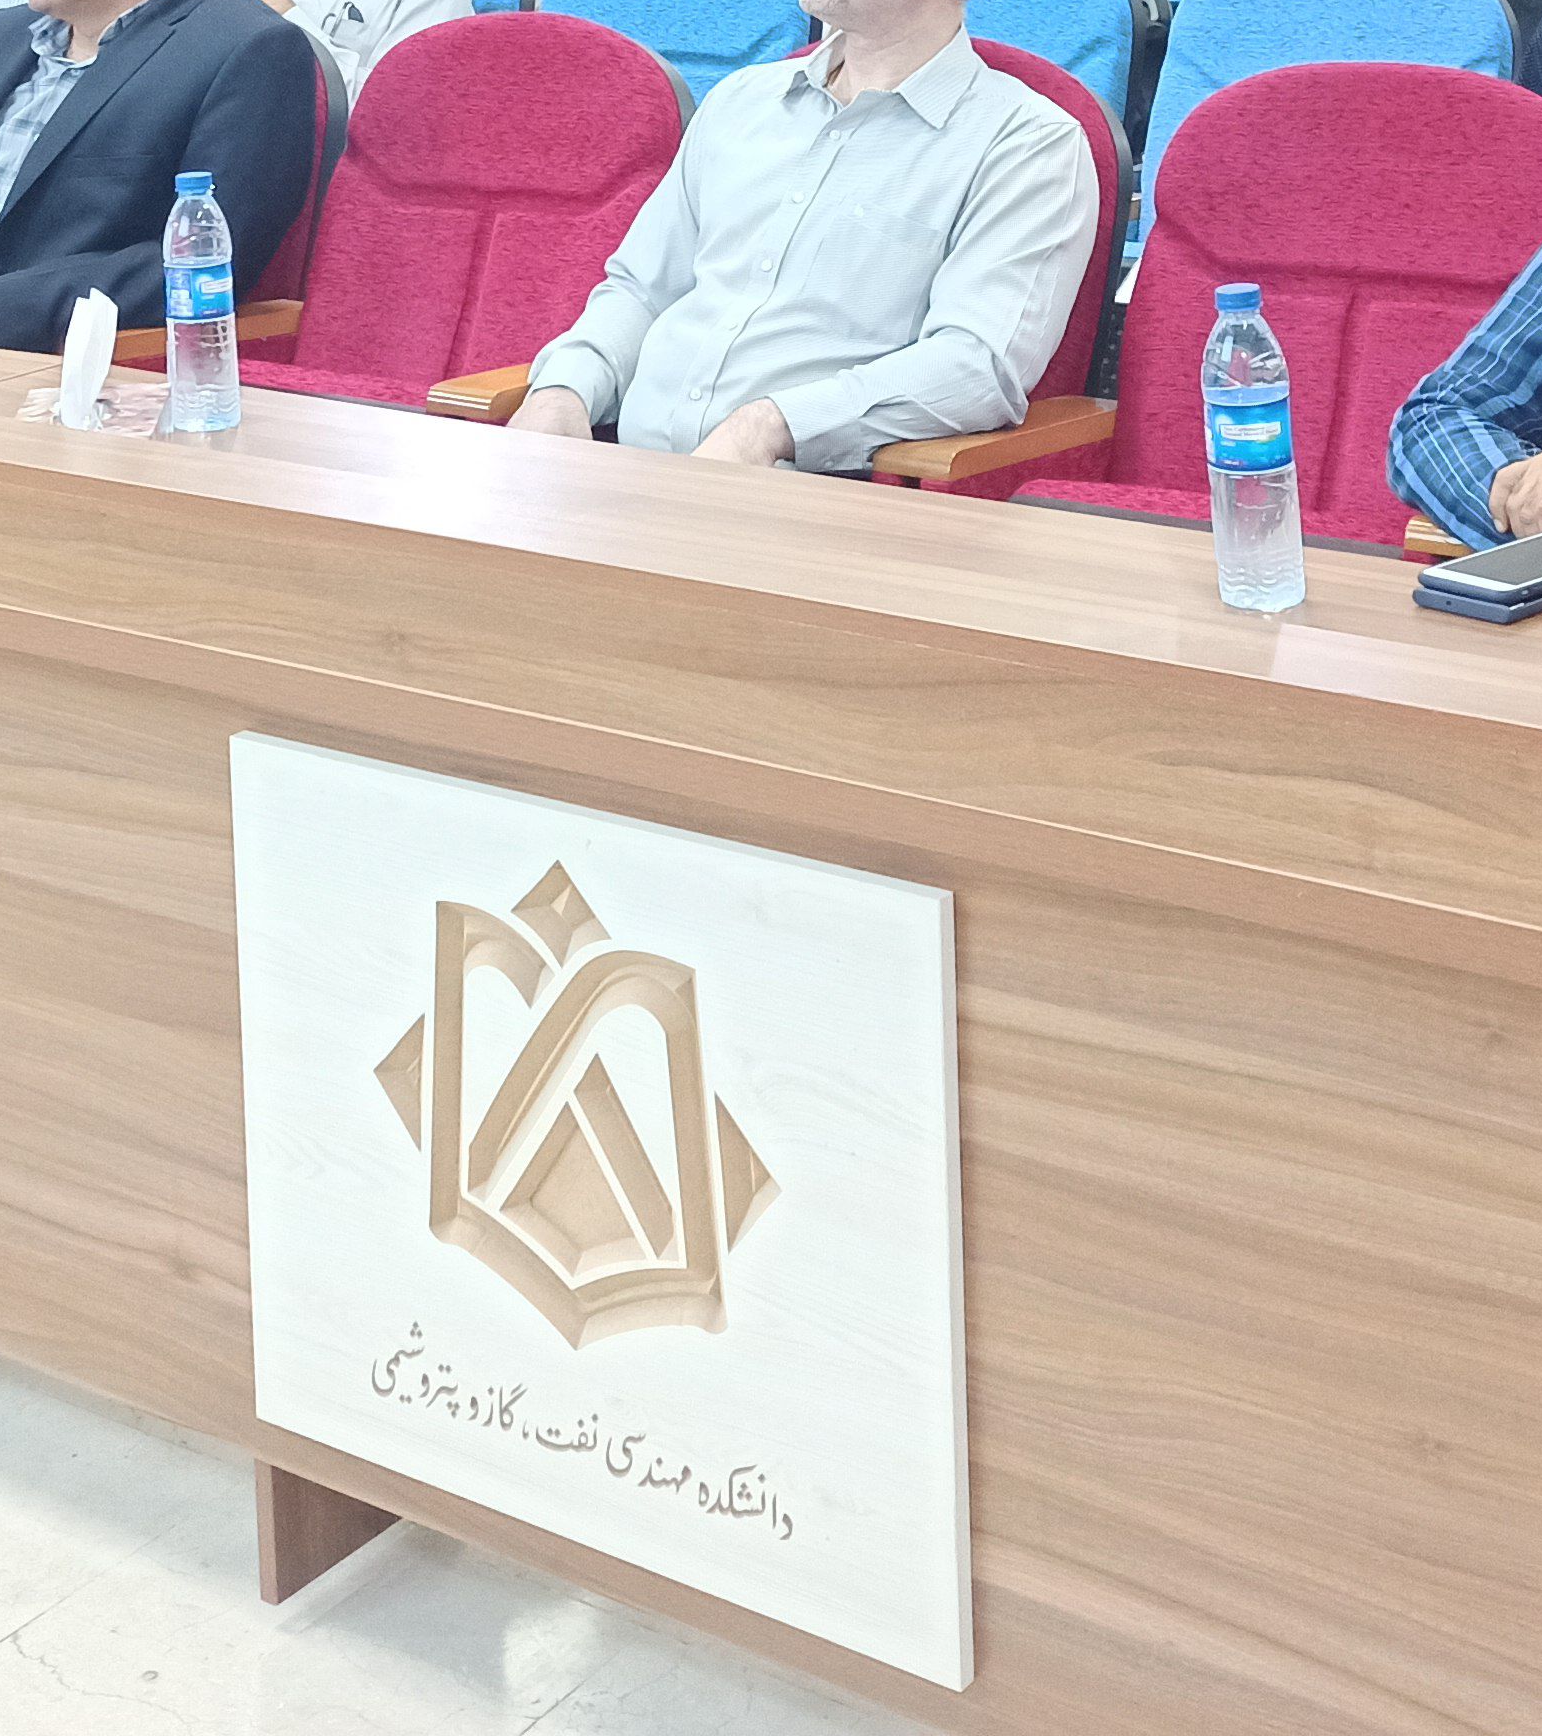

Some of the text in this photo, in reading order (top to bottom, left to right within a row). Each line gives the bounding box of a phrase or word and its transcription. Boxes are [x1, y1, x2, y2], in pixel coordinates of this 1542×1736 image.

[482, 1383, 528, 1432] گاز
[605, 1433, 692, 1494] مهندسی
[698, 1464, 794, 1541] دانشکده
